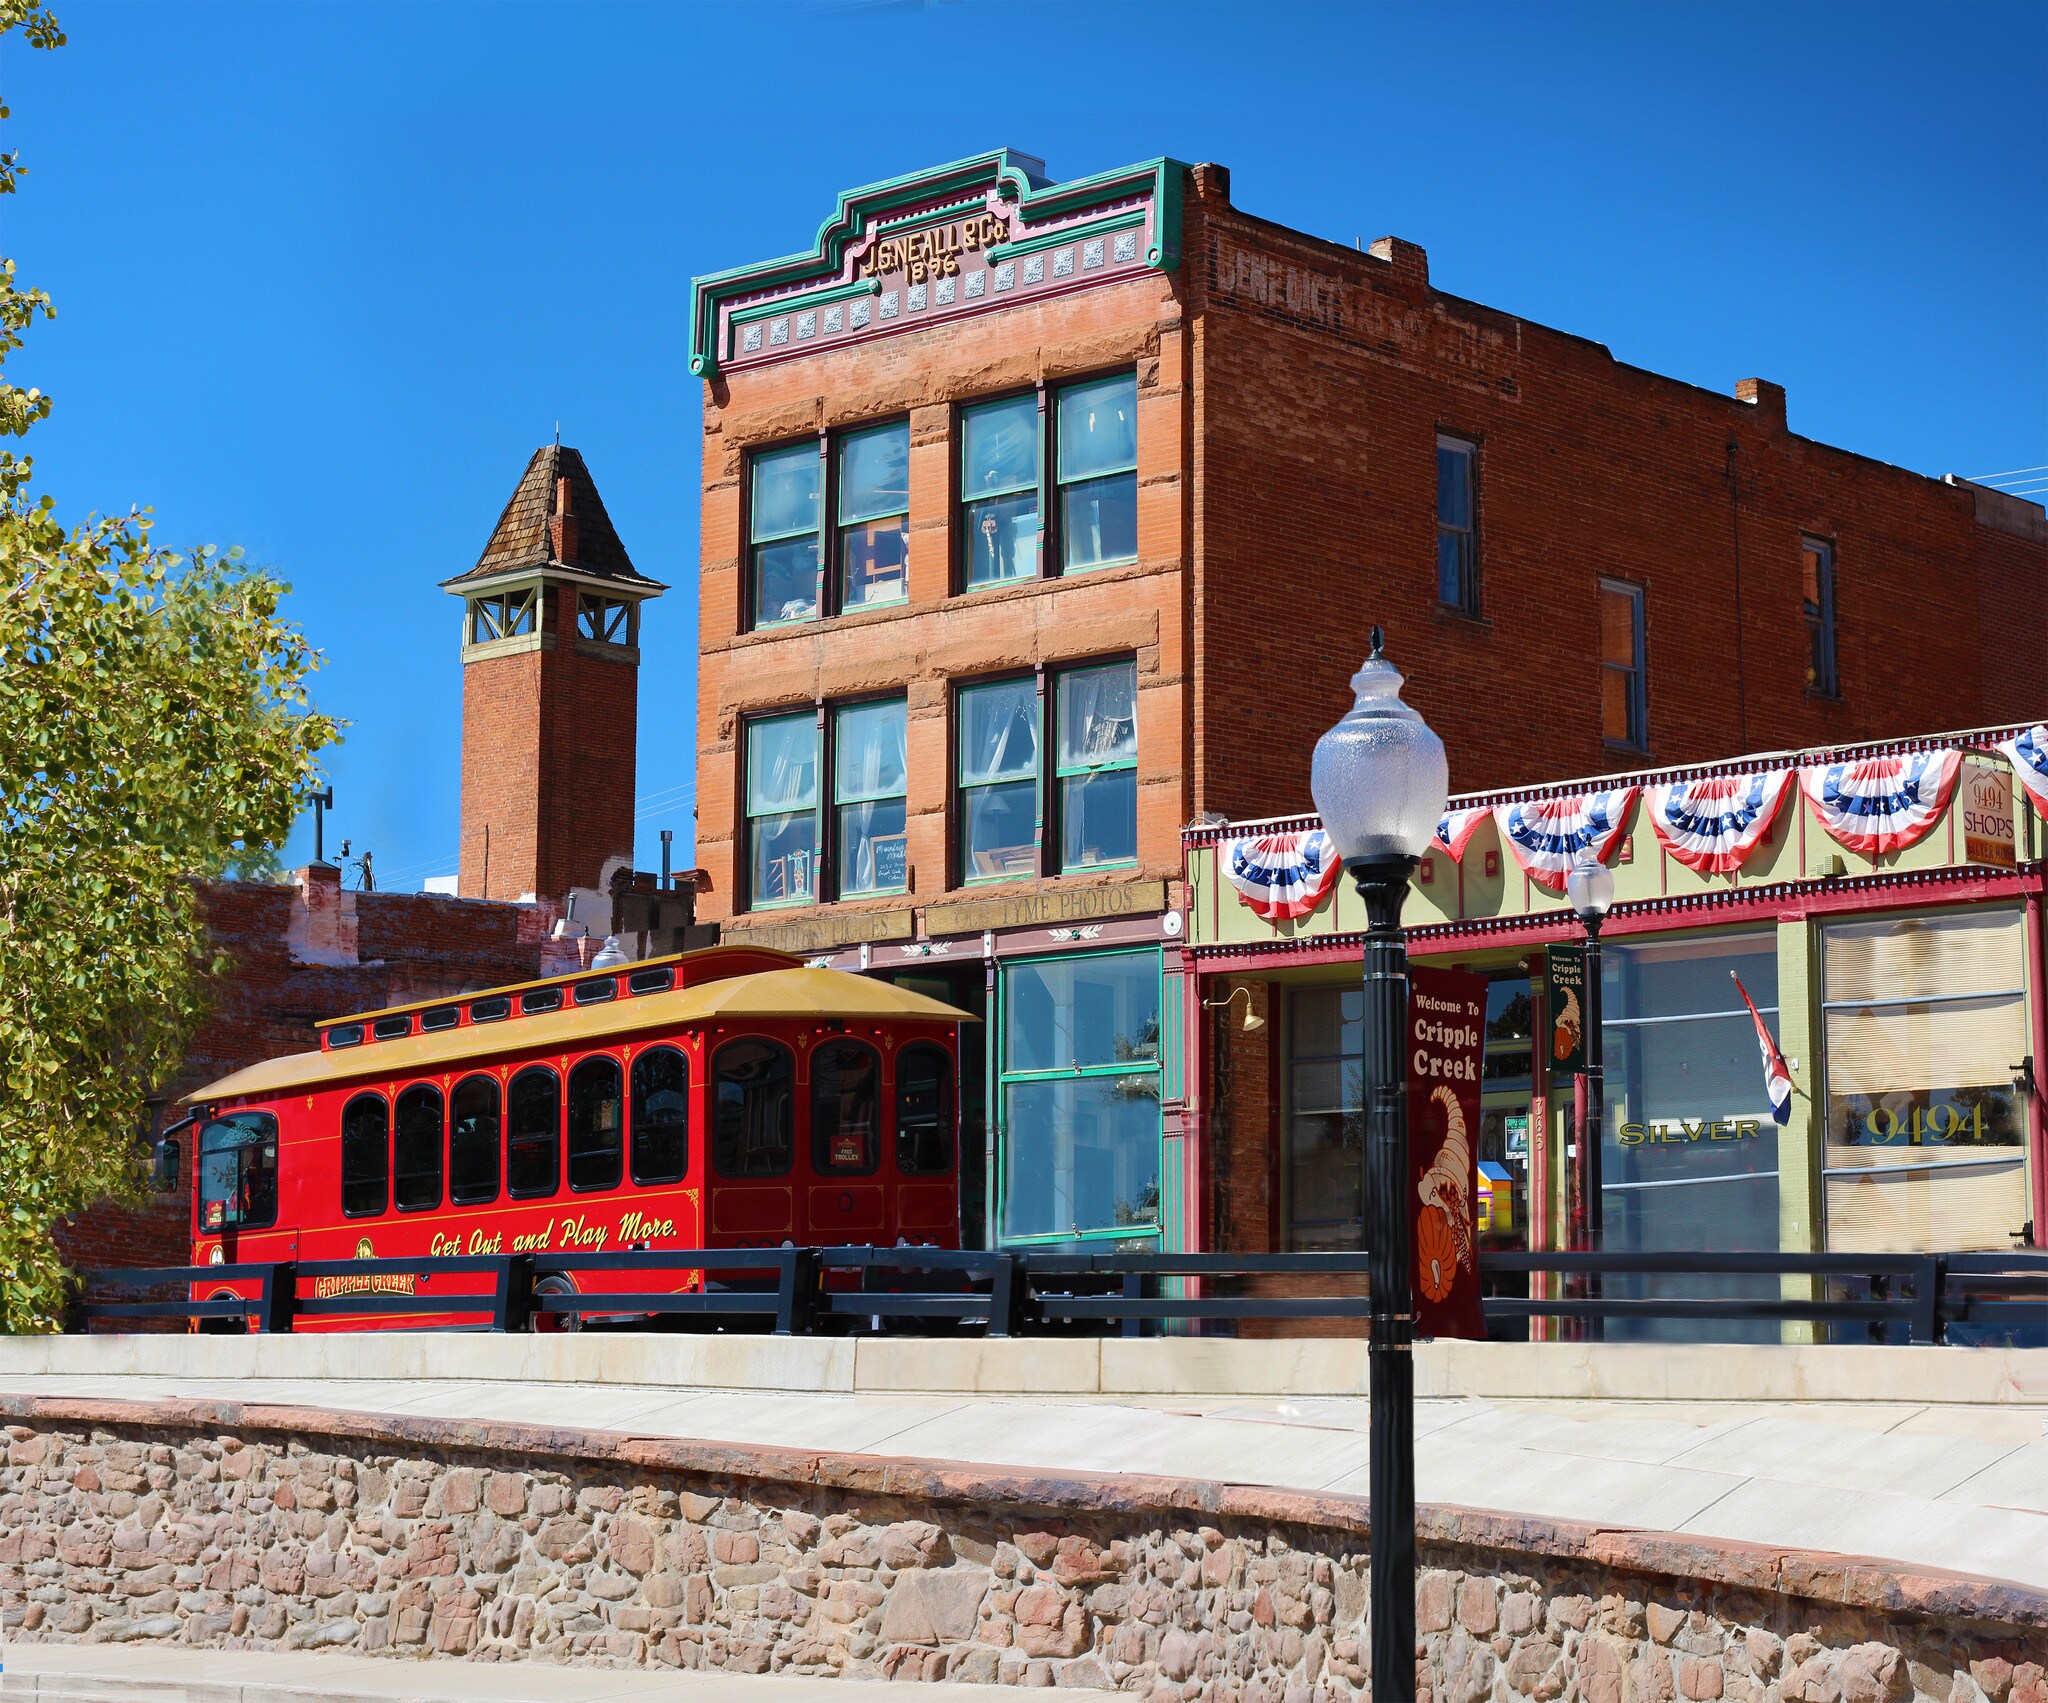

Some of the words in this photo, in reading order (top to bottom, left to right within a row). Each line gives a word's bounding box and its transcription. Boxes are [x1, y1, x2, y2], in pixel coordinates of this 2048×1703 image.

[904, 252, 959, 284] 1896
[1973, 783, 2003, 809] 9494
[1964, 810, 2014, 839] SHOPS
[1002, 896, 1051, 925] TYME
[1059, 886, 1134, 920] PHOTOS
[1551, 963, 1582, 975] Cripple
[1552, 974, 1582, 985] Creek
[1415, 994, 1461, 1014] Welcome
[1467, 1001, 1479, 1016] To
[1414, 1018, 1478, 1050] Cripple
[1413, 1049, 1476, 1081] Creek
[1619, 1119, 1761, 1146] SILVER
[1866, 1102, 1990, 1145] 9494
[430, 1231, 461, 1257] Get
[468, 1228, 502, 1256] Out
[512, 1218, 555, 1252] and
[559, 1214, 608, 1252] Play
[618, 1211, 678, 1242] More.
[315, 1274, 371, 1299] CRIPPLE
[371, 1273, 415, 1296] CREEK
